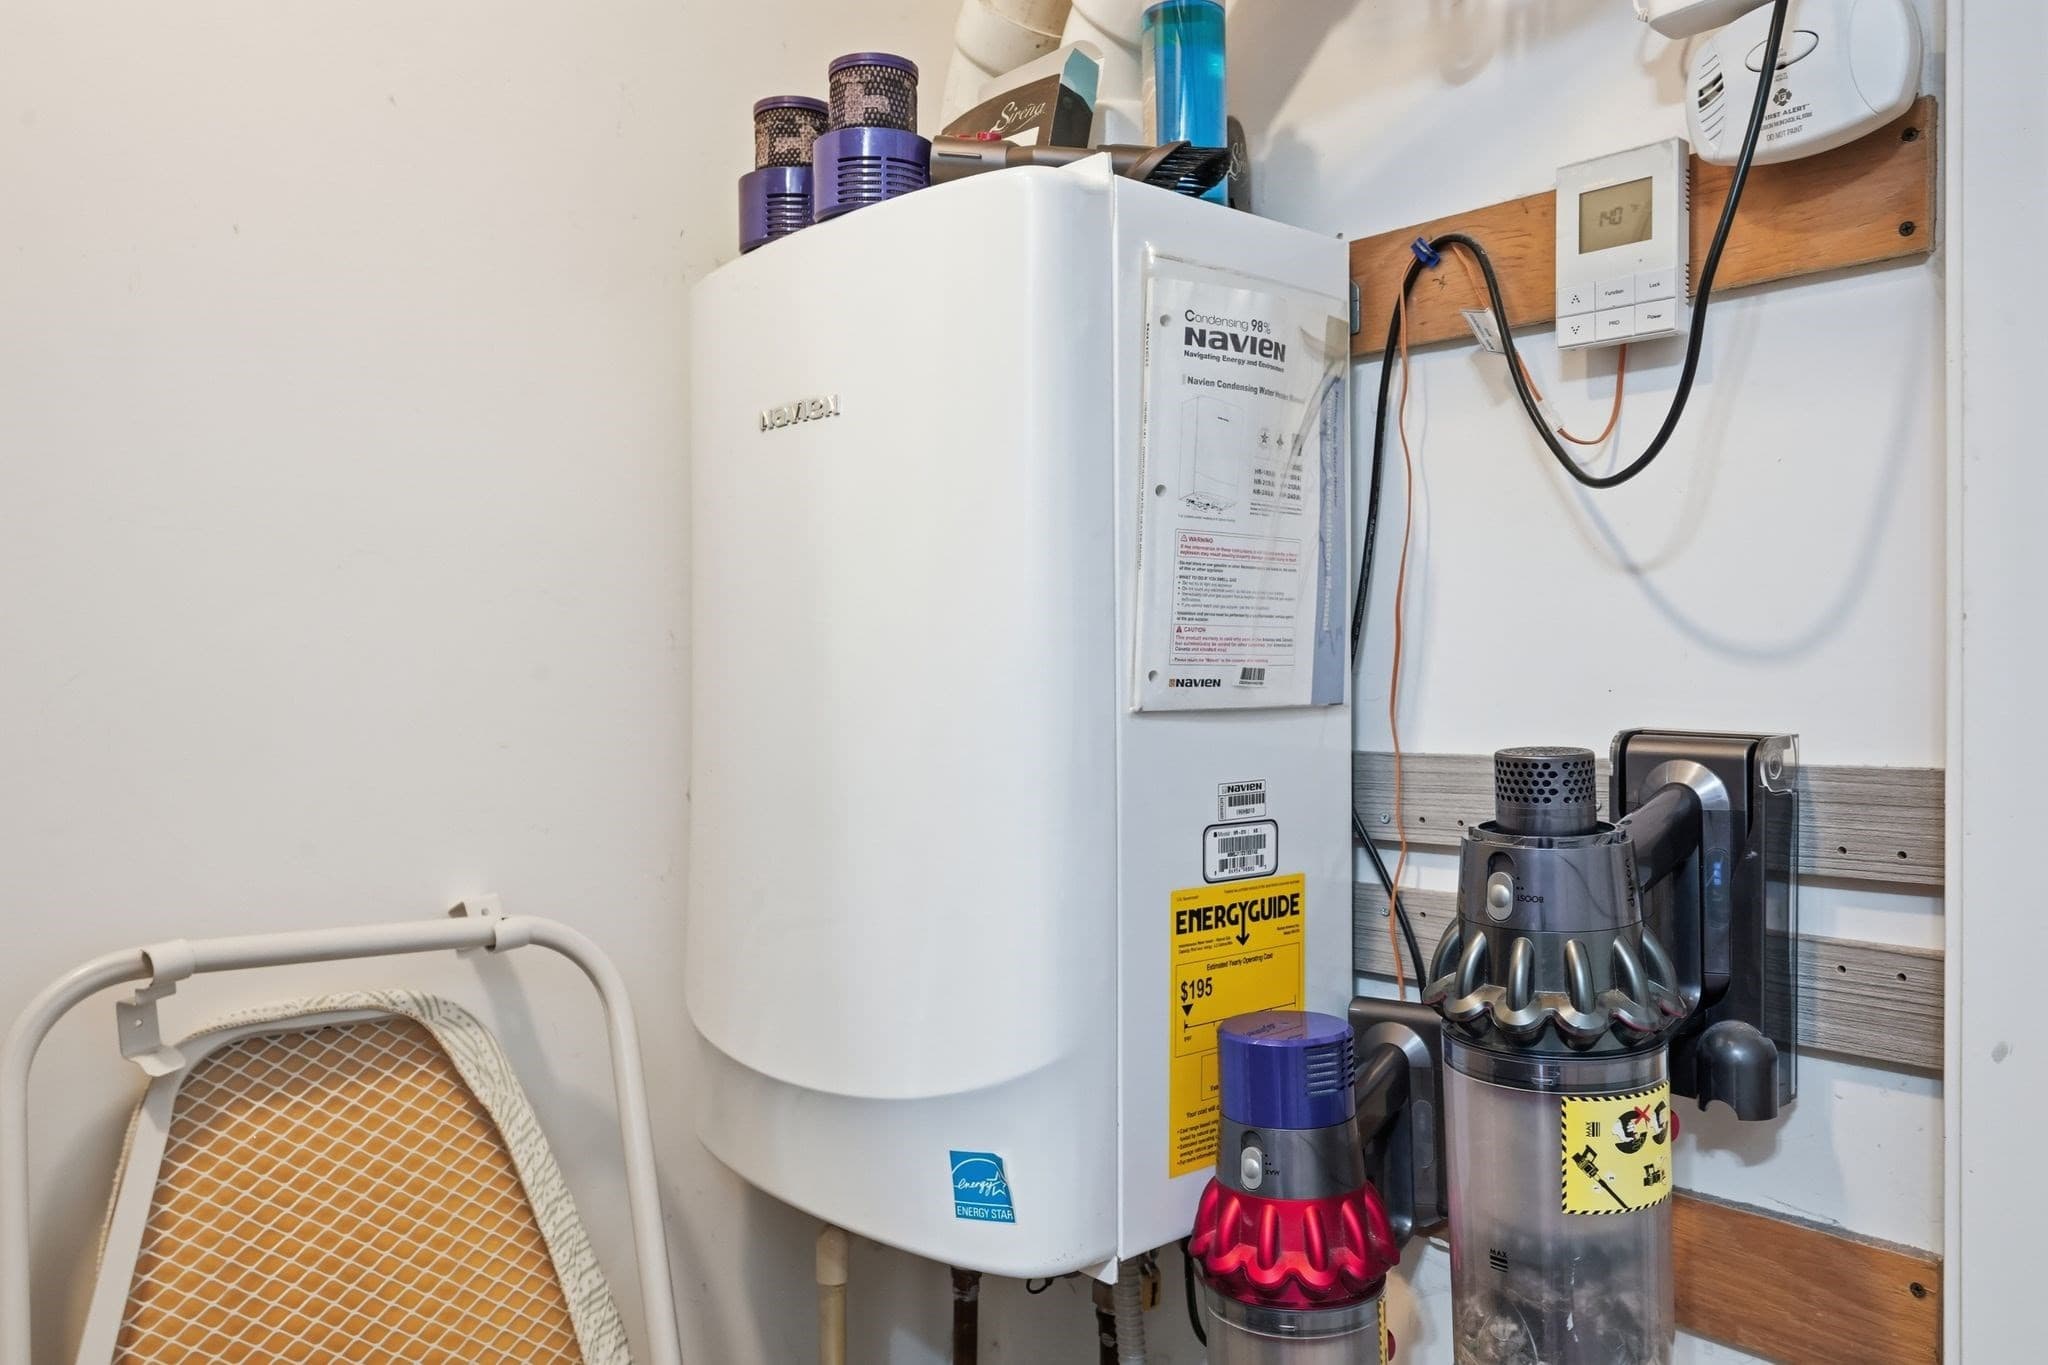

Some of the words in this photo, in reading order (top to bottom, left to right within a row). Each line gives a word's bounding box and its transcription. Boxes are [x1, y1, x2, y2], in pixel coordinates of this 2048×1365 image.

[1764, 111, 1782, 120] IRST
[1184, 309, 1249, 332] Condensing
[1250, 319, 1271, 334] 98%
[1184, 350, 1220, 364] Navigating
[1222, 354, 1246, 366] Energy
[1246, 358, 1258, 366] and
[1187, 376, 1215, 387] Navien
[1216, 380, 1258, 396] Condensing
[1259, 386, 1274, 396] Water
[1516, 894, 1544, 904] BOOST
[1176, 893, 1300, 935] ENERGYGUIDE
[1207, 961, 1228, 971] Estimated
[1242, 954, 1264, 965] Operating
[1180, 977, 1213, 1002] $195
[957, 1205, 989, 1219] ENERGY
[991, 1209, 1014, 1220] STAR
[1490, 1248, 1507, 1258] MAX
